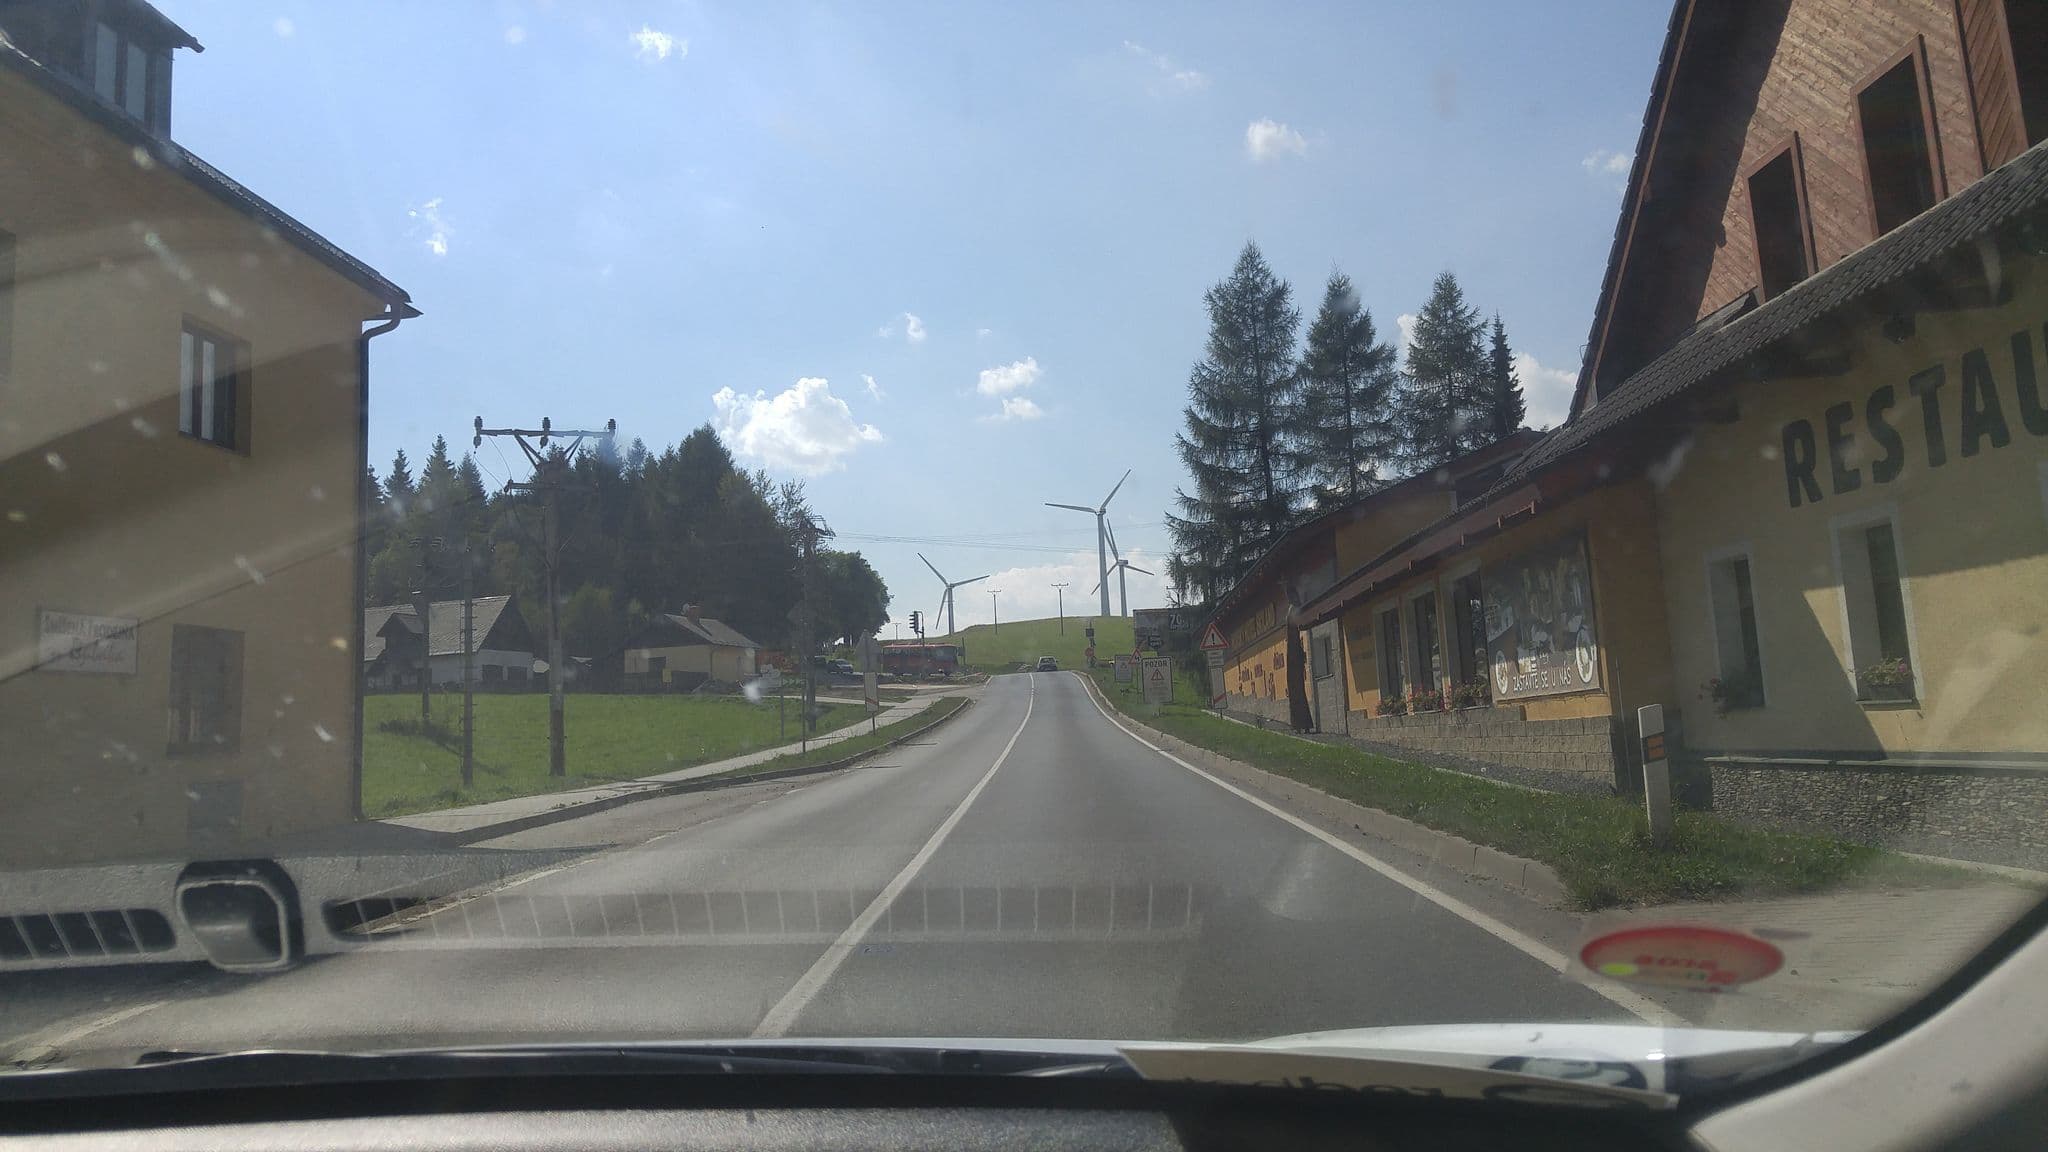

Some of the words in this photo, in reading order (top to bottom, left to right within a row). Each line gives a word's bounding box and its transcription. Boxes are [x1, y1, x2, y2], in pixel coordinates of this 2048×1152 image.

[1782, 321, 2048, 508] RESTAU
[1144, 660, 1168, 668] POZOR
[1541, 671, 1549, 688] SE
